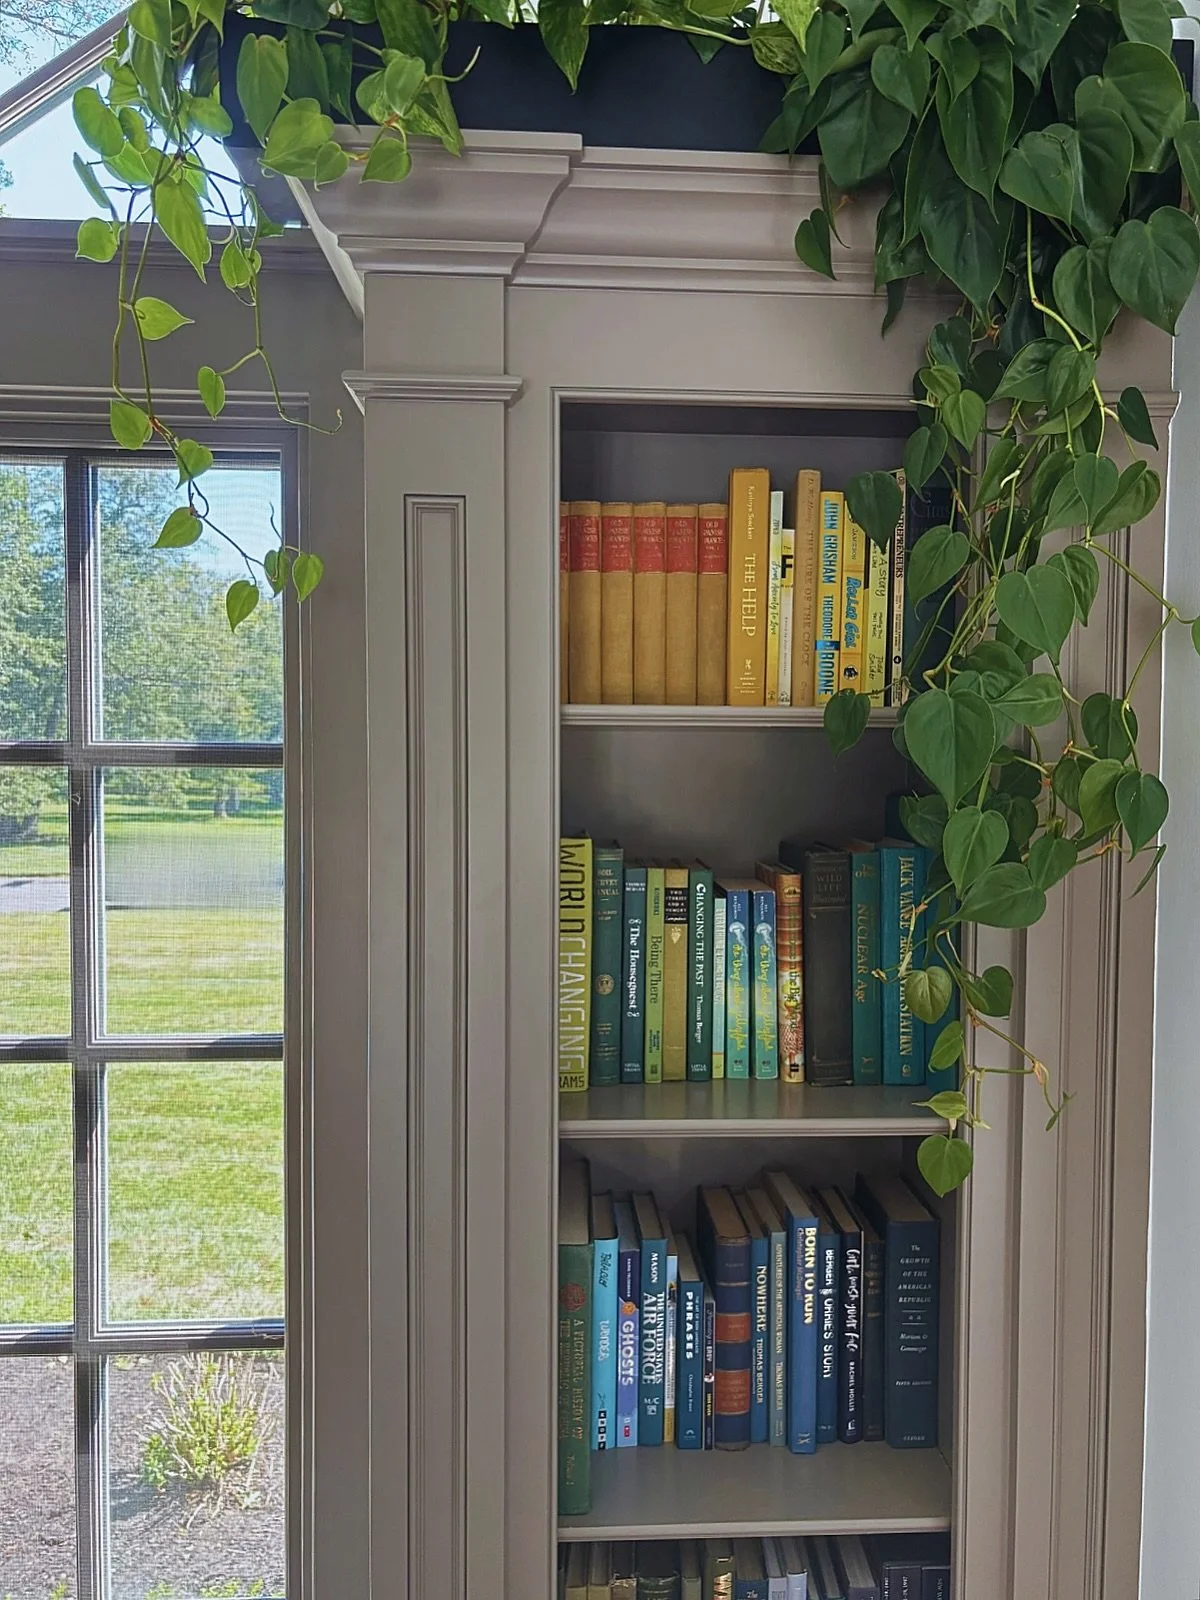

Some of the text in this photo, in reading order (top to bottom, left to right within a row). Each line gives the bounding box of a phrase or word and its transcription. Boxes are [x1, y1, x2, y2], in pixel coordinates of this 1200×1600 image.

[806, 530, 814, 553] THE
[822, 500, 839, 584] JOHN GRISHAM
[895, 506, 905, 579] TREPRENEURS
[781, 554, 794, 579] F
[878, 557, 887, 567] A
[742, 554, 757, 637] THE HELP
[804, 588, 812, 602] OF
[803, 604, 812, 629] THE
[822, 595, 834, 639] THEODORE
[801, 632, 811, 667] CLOCK
[818, 652, 834, 695] BOONE
[898, 856, 915, 888] JACK
[696, 883, 707, 939] CHANGING
[899, 889, 914, 930] VANCE
[627, 927, 641, 1009] The Houseguest
[696, 940, 705, 962] THE
[855, 903, 869, 1004] NUCLEAR Age
[648, 935, 663, 1004] Being There
[695, 964, 705, 987] PAST
[789, 972, 800, 986] the
[785, 987, 801, 1002] Big
[694, 1022, 703, 1043] Berger
[899, 1001, 913, 1056] STATION
[650, 1252, 659, 1284] MASON
[775, 1243, 784, 1280] ADVENTURES
[804, 1227, 817, 1325] BORN TO RUN
[756, 1265, 767, 1332] NOWHERE
[775, 1288, 783, 1300] THE
[848, 1276, 859, 1301] wash
[573, 1319, 585, 1327] A
[685, 1291, 694, 1359] PHRASES
[823, 1249, 835, 1378] BERGER ORRIE'S STORY
[844, 1303, 858, 1329] your
[621, 1320, 635, 1386] GHOSTS
[642, 1292, 658, 1384] AIR FORCE
[654, 1292, 666, 1384] THE UNITED STATES
[775, 1331, 783, 1354] WOMAN
[844, 1332, 860, 1353] face
[756, 1338, 764, 1404] THOMAS BERGER
[775, 1361, 784, 1387] THOMAS
